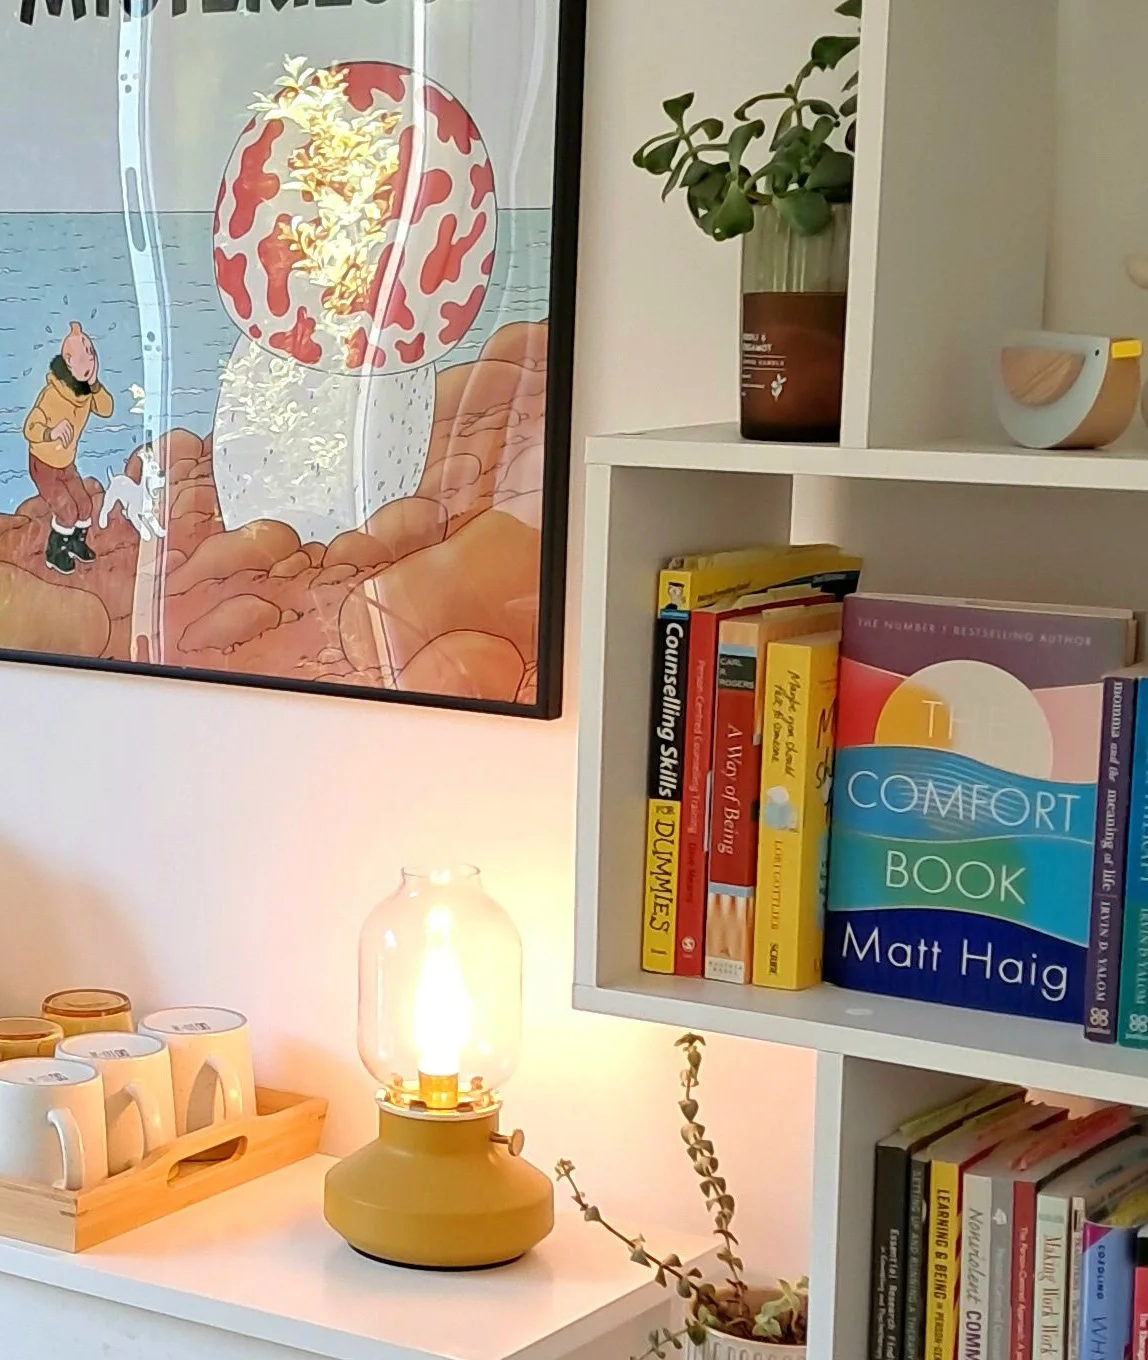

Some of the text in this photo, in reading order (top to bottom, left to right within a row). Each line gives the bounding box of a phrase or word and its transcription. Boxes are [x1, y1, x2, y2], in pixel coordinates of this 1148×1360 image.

[858, 618, 879, 628] THE
[884, 620, 937, 634] NUMBER
[953, 626, 1034, 642] BESTSELLING
[1040, 634, 1092, 646] AUTHOR
[656, 622, 685, 797] Counselling Skills
[786, 670, 802, 712] Maybe
[1109, 680, 1123, 737] momma
[1108, 742, 1120, 764] and
[716, 723, 742, 854] A Way of Being
[848, 770, 1080, 832] COMFORT
[1100, 788, 1119, 848] meaning
[649, 819, 675, 934] DUMMIES
[886, 850, 1026, 904] BOOK
[1100, 869, 1115, 891] life
[1098, 901, 1111, 938] IRVIN
[842, 922, 1067, 1002] Matt Haig
[1095, 957, 1108, 1002] YALOM
[935, 1188, 950, 1247] LEARNING
[887, 1228, 900, 1278] Essential
[909, 1233, 920, 1253] AND
[935, 1251, 948, 1259] &
[964, 1208, 989, 1304] Nonviolent
[1039, 1235, 1061, 1281] Making
[933, 1264, 947, 1299] BEING
[1041, 1288, 1060, 1317] Work
[885, 1284, 897, 1329] Research
[905, 1316, 917, 1360] THERAPY
[1039, 1324, 1059, 1354] Work
